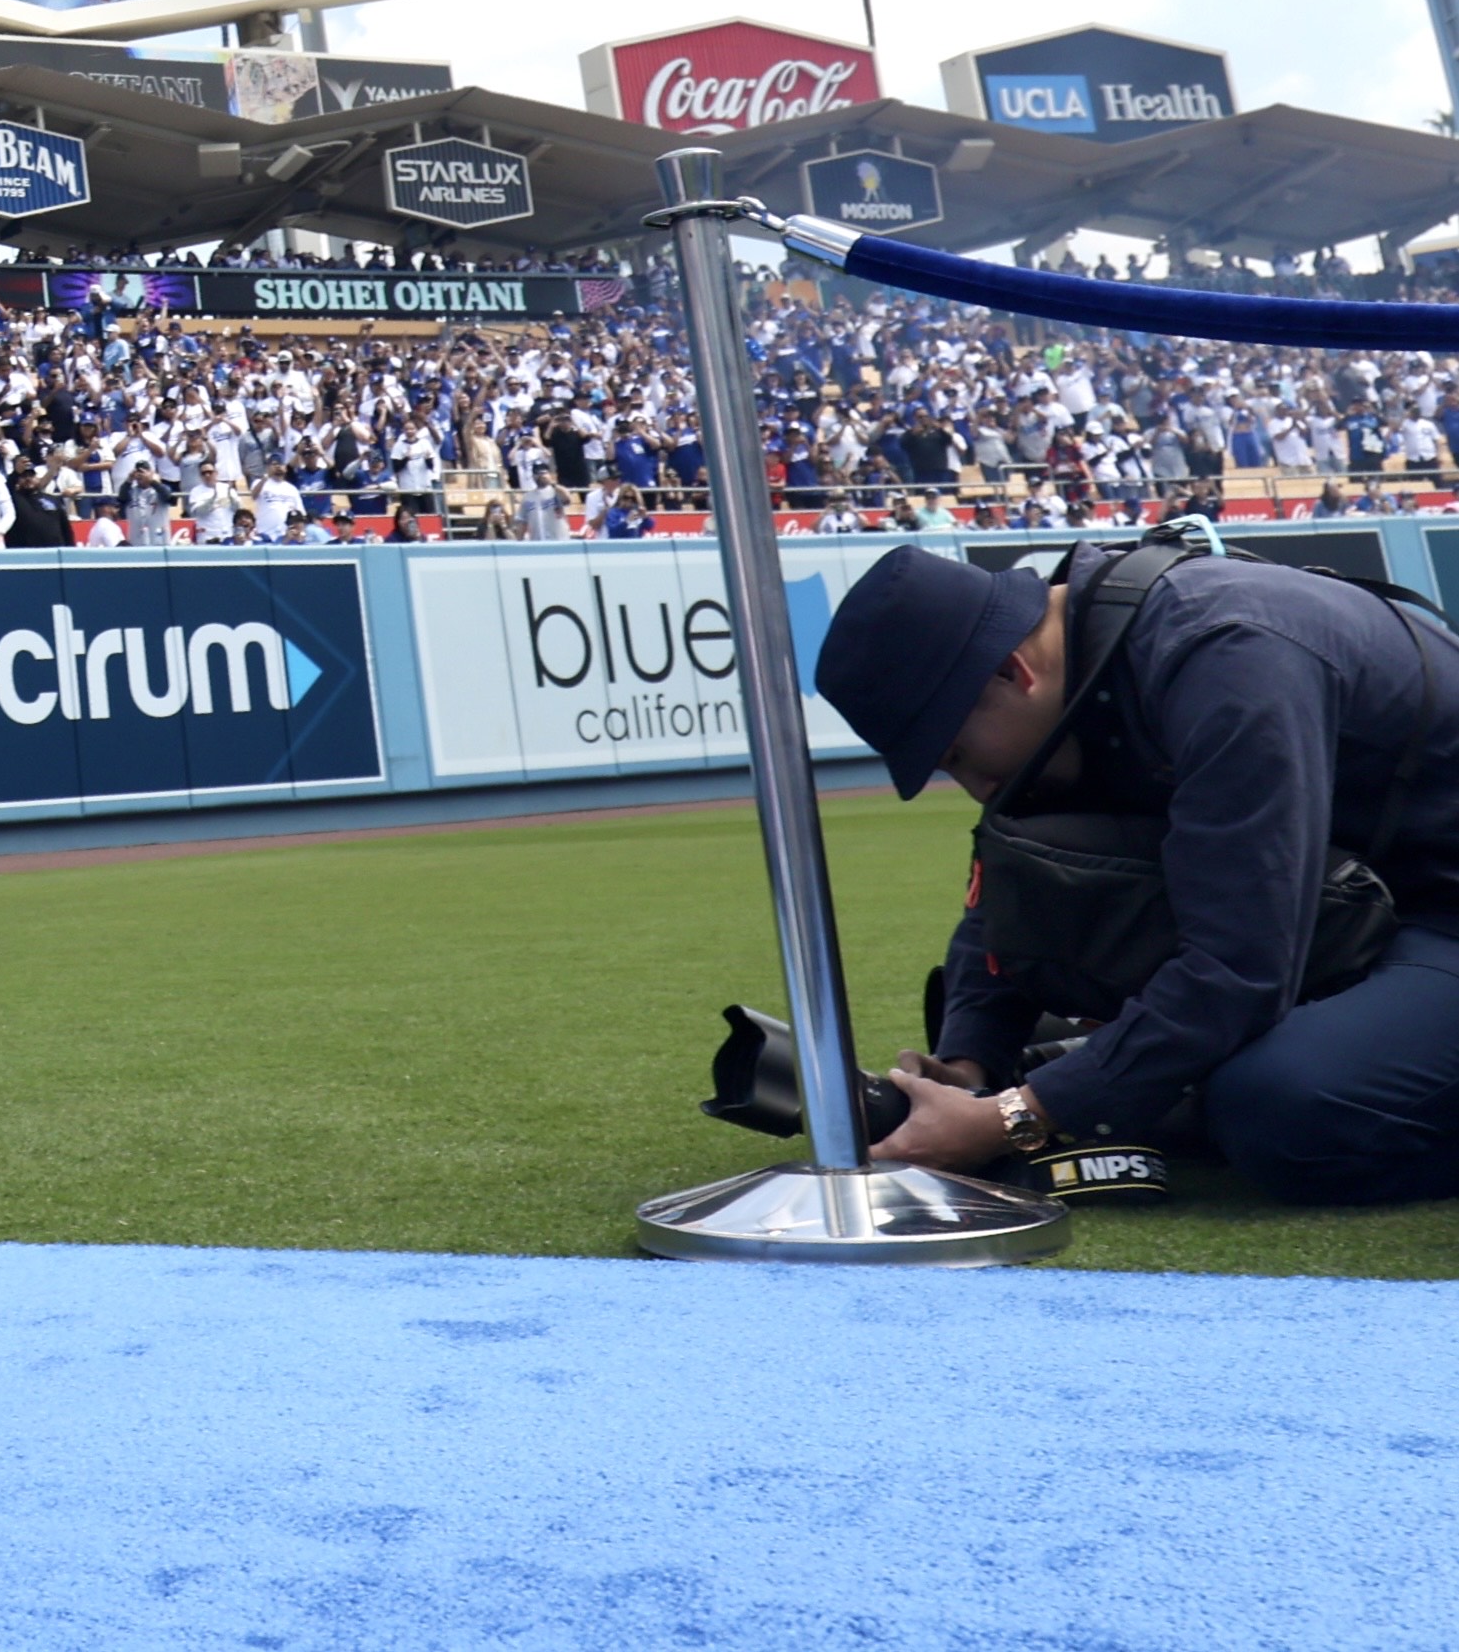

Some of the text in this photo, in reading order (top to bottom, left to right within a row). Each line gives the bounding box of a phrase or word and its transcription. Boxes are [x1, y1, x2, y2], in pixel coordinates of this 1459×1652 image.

[999, 83, 1225, 121] UCLA Health
[395, 159, 521, 185] STARLUX
[419, 186, 506, 204] AIRLINES
[840, 203, 913, 220] MORTON
[254, 278, 526, 312] SHOHEI OHTANI
[522, 575, 738, 688] blue
[576, 693, 739, 744] californ
[1079, 1154, 1150, 1182] NPS
